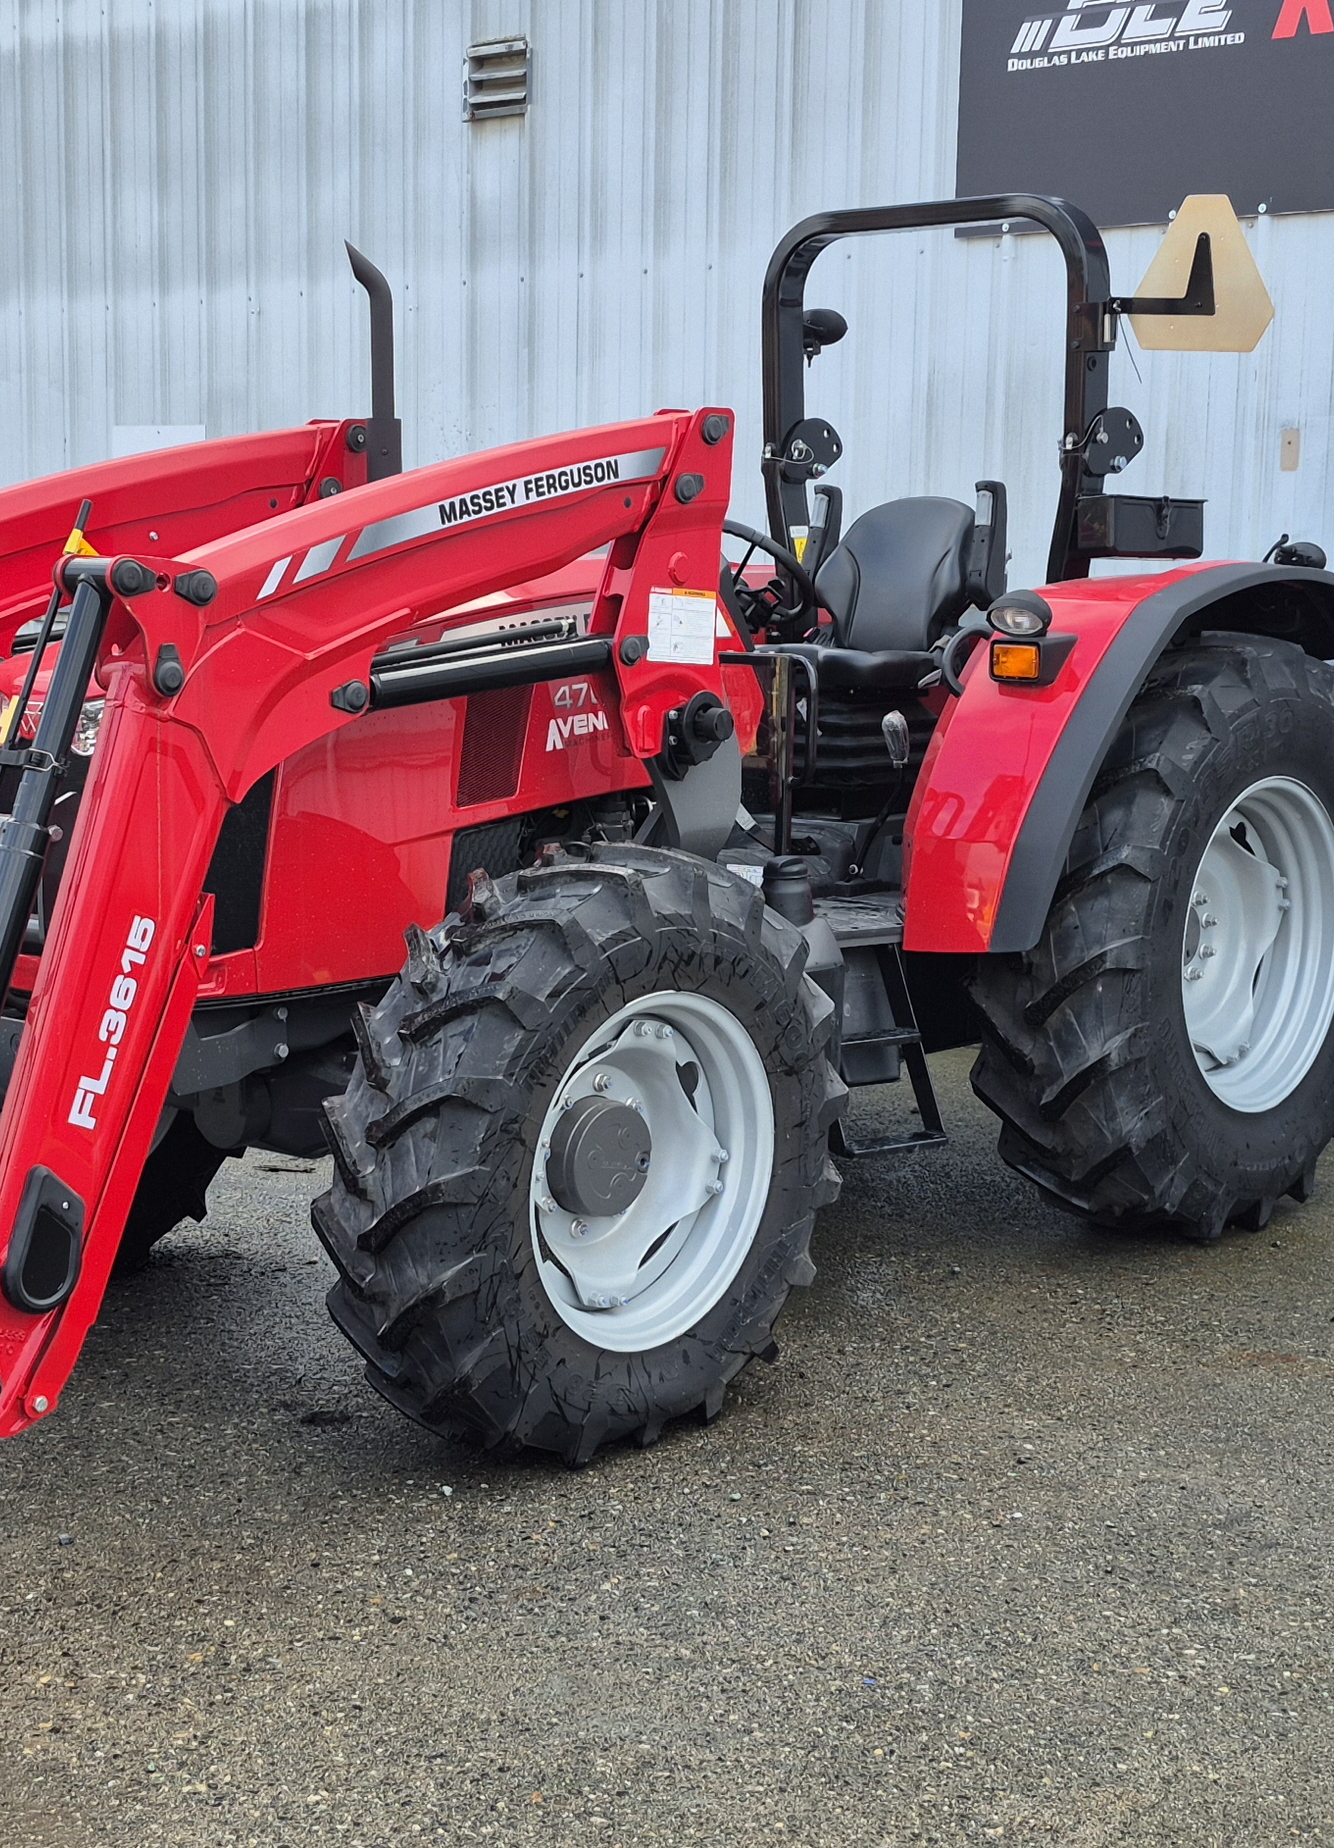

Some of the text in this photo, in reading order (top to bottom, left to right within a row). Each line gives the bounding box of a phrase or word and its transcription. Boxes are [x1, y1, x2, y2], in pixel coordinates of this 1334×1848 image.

[438, 458, 620, 526] MASSEY FERGUSON
[545, 710, 609, 752] AVEN
[67, 915, 156, 1130] FL.3615
